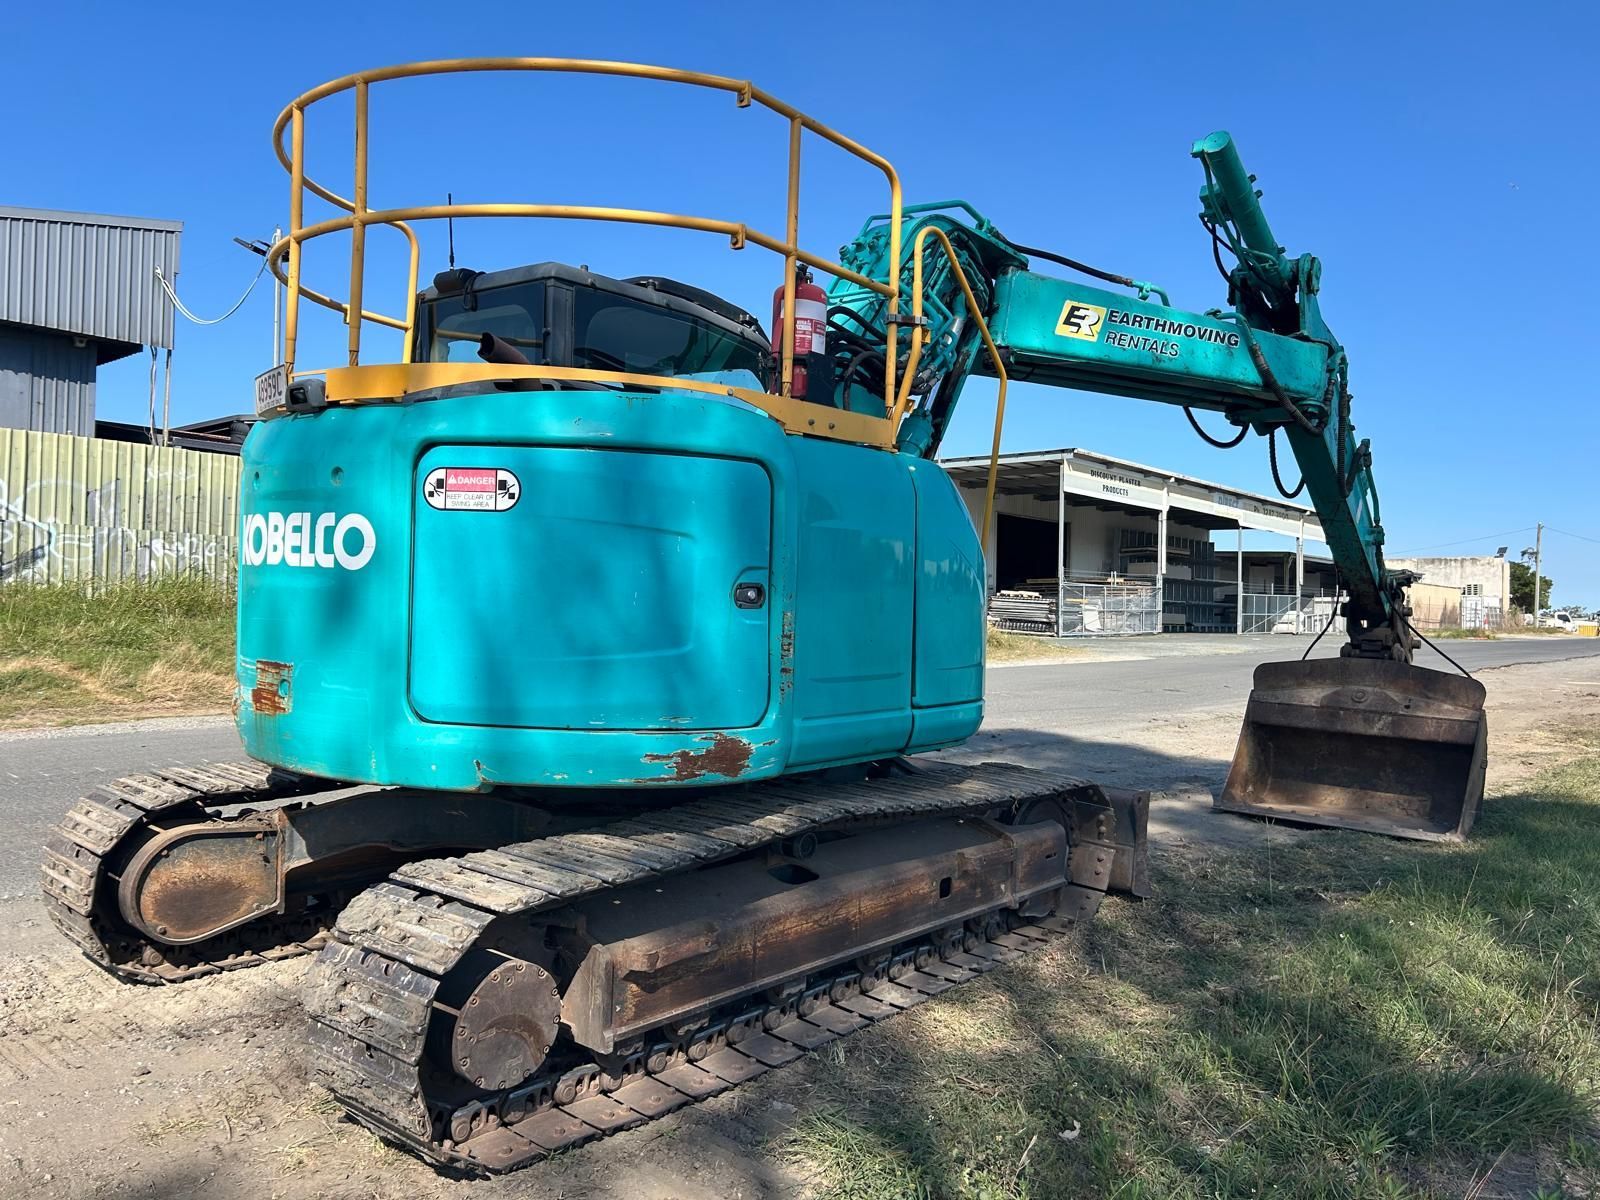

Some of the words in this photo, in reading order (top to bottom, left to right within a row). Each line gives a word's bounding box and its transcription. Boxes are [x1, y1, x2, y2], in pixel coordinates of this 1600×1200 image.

[1106, 309, 1240, 347] EARTHMOVING
[1105, 330, 1180, 357] RENTALS
[457, 476, 496, 485] DANGER
[1090, 469, 1118, 482] DISCOUNT
[1118, 475, 1141, 486] PLASTER
[1102, 484, 1129, 496] PRODUCTS
[242, 511, 377, 571] KOBELCO
